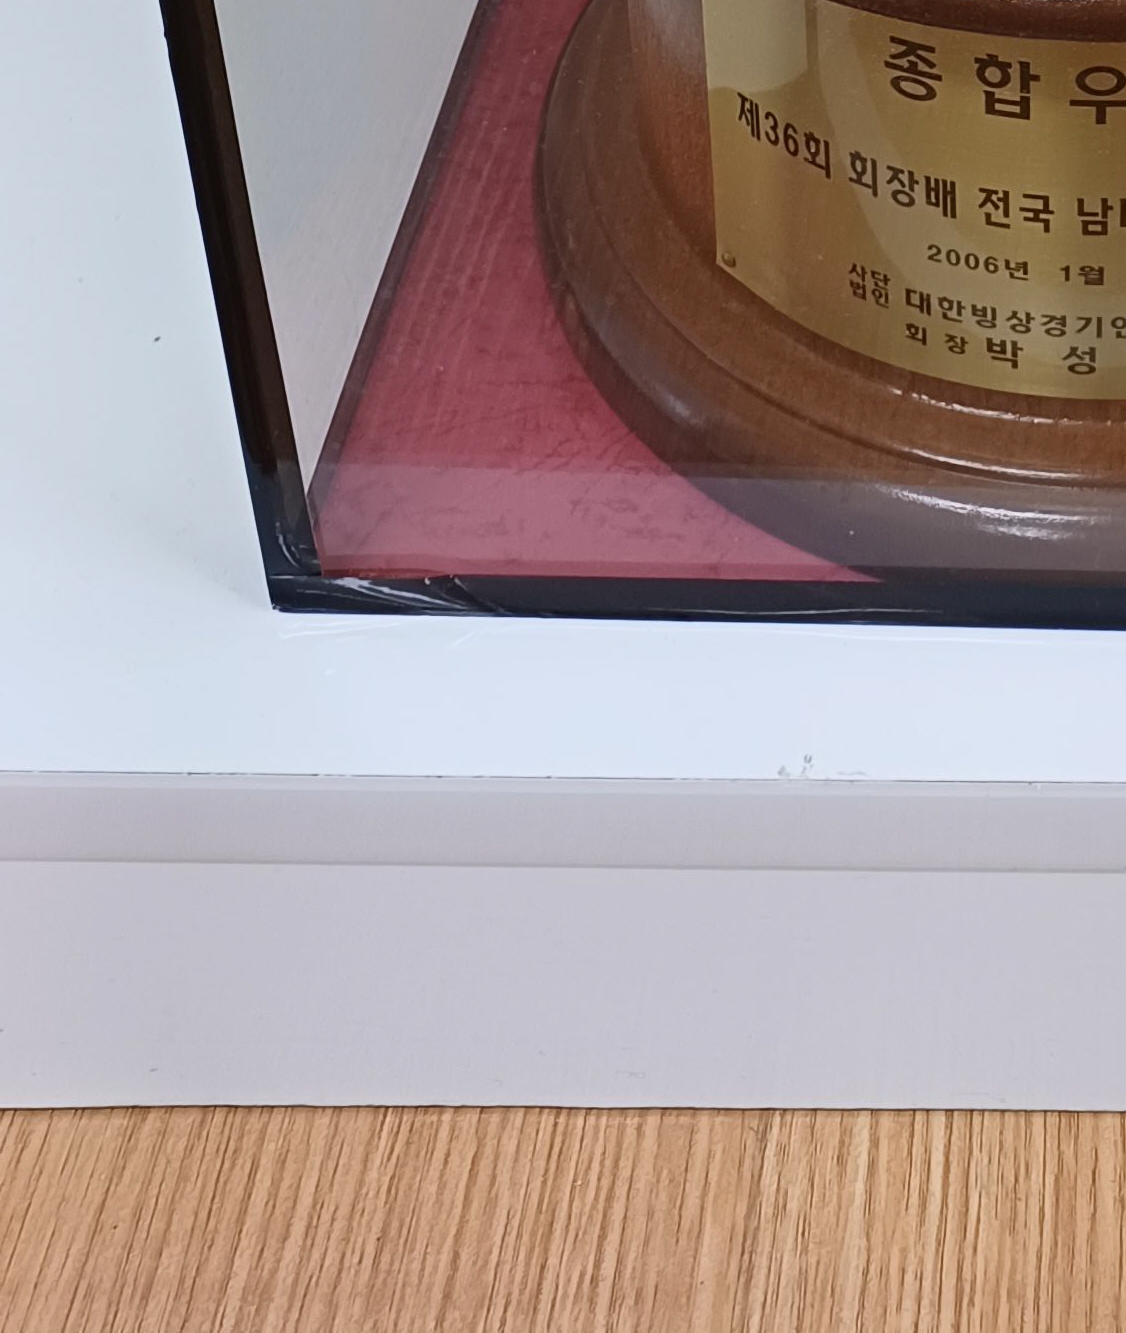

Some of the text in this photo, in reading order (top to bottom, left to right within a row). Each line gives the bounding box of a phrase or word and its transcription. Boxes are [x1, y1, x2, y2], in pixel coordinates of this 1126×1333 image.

[736, 92, 832, 179] 제36회
[848, 150, 957, 220] 회장배
[977, 186, 1055, 233] 전국
[848, 262, 892, 290] 사단
[926, 244, 1030, 281] 2006년
[1059, 263, 1106, 286] 1월
[849, 280, 890, 309] 법인
